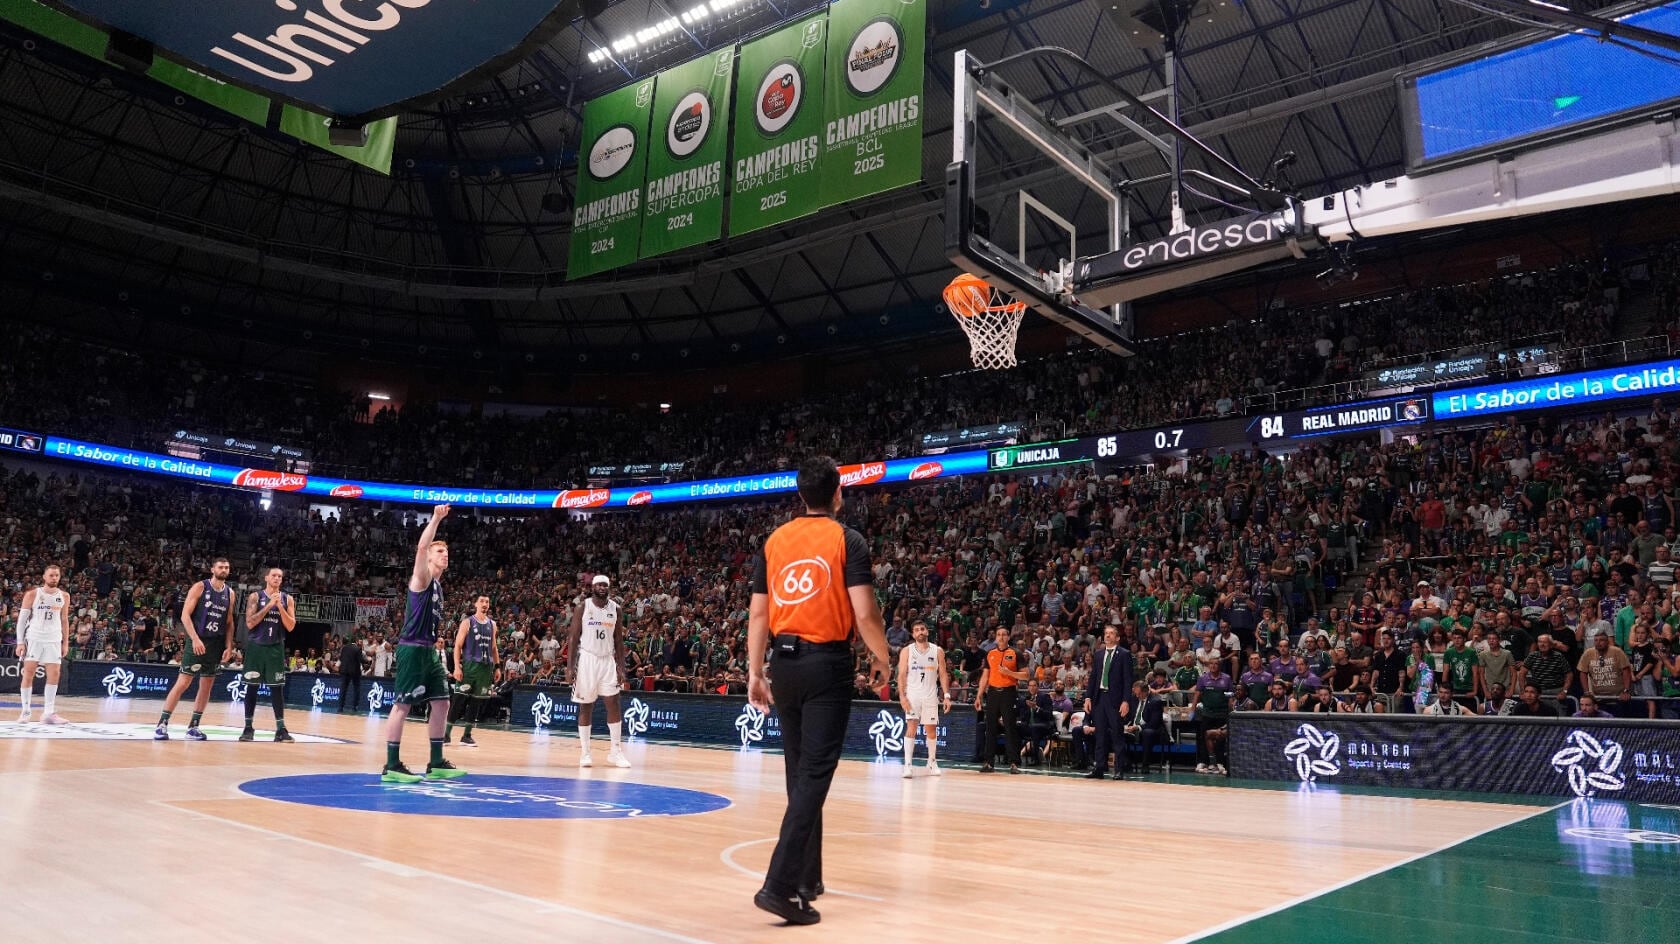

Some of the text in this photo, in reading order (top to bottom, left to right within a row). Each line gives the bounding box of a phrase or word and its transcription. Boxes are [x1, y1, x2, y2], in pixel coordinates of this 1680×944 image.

[826, 95, 919, 145] CAMPEONES
[856, 137, 883, 156] BCL
[736, 135, 818, 181] CAMPEONES
[854, 154, 885, 175] 2025
[647, 161, 721, 203] CAMPEONES
[736, 158, 817, 193] COPA DEL REY
[574, 188, 640, 228] CAMPEONES
[647, 184, 720, 217] SUPERCOPA
[760, 190, 787, 211] 2025
[667, 213, 693, 230] 2024
[591, 237, 615, 254] 2024
[1123, 218, 1273, 268] endesa
[1450, 396, 1466, 413] El
[1474, 389, 1541, 410] Sabor
[1547, 382, 1575, 400] de
[1584, 378, 1603, 396] la
[1261, 416, 1284, 438] 84
[1303, 406, 1391, 431] REAL MADRID
[1098, 436, 1117, 457] 85
[1154, 429, 1184, 449] 0.7
[57, 442, 212, 477] El Sabor de la Calidad
[1017, 448, 1059, 463] UNICAJA
[413, 490, 536, 505] El Sabor de la Calidad
[691, 485, 699, 496] El
[702, 482, 731, 496] Sabor
[733, 481, 746, 492] de
[750, 479, 759, 491] la
[783, 569, 814, 594] 66
[44, 611, 53, 620] 13
[206, 621, 219, 632] 45
[268, 626, 273, 637] 1
[596, 629, 606, 640] 16
[920, 672, 925, 683] 7
